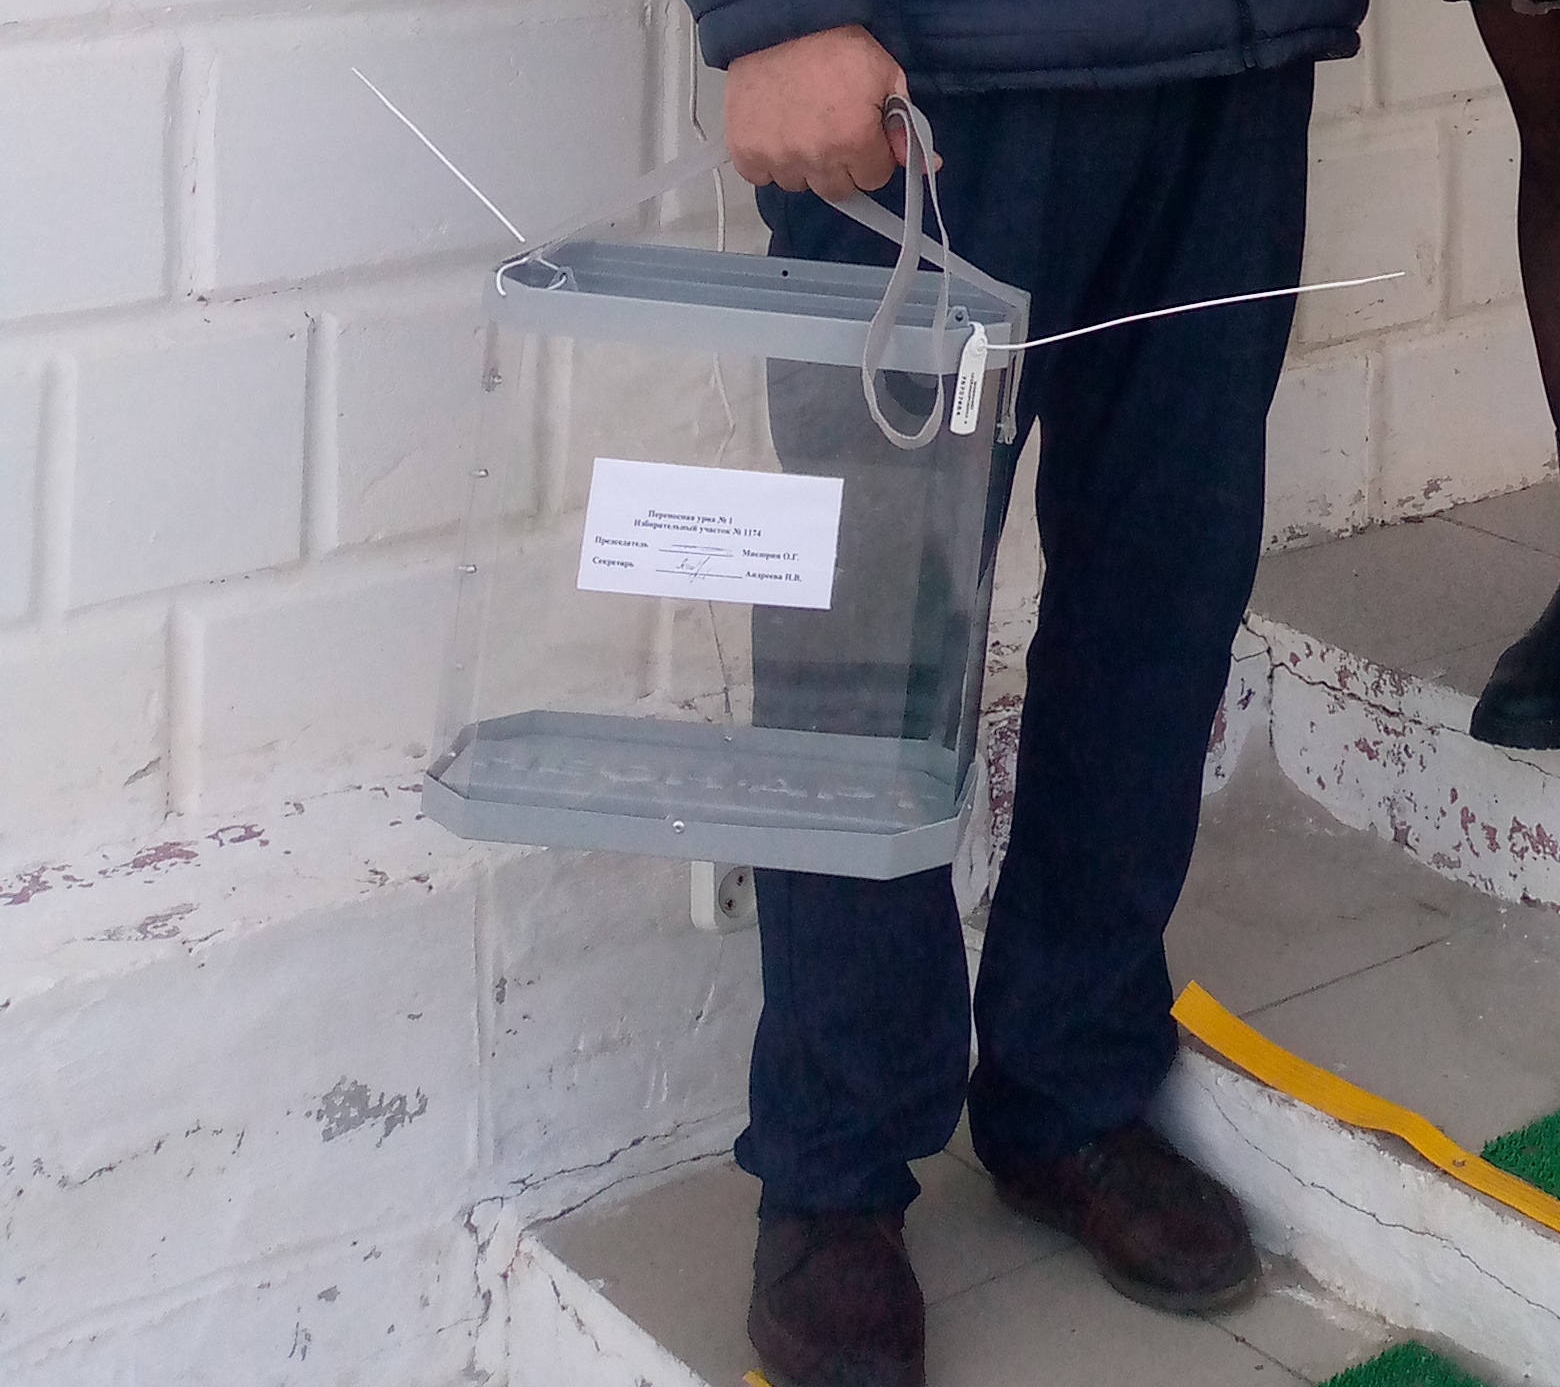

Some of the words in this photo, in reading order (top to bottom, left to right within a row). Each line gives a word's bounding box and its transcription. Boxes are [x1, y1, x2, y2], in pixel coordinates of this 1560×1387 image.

[648, 509, 696, 523] Переносная
[633, 518, 698, 534] Избирательный
[699, 524, 731, 536] участок
[743, 528, 762, 538] 1174
[592, 556, 635, 569] Секретарь
